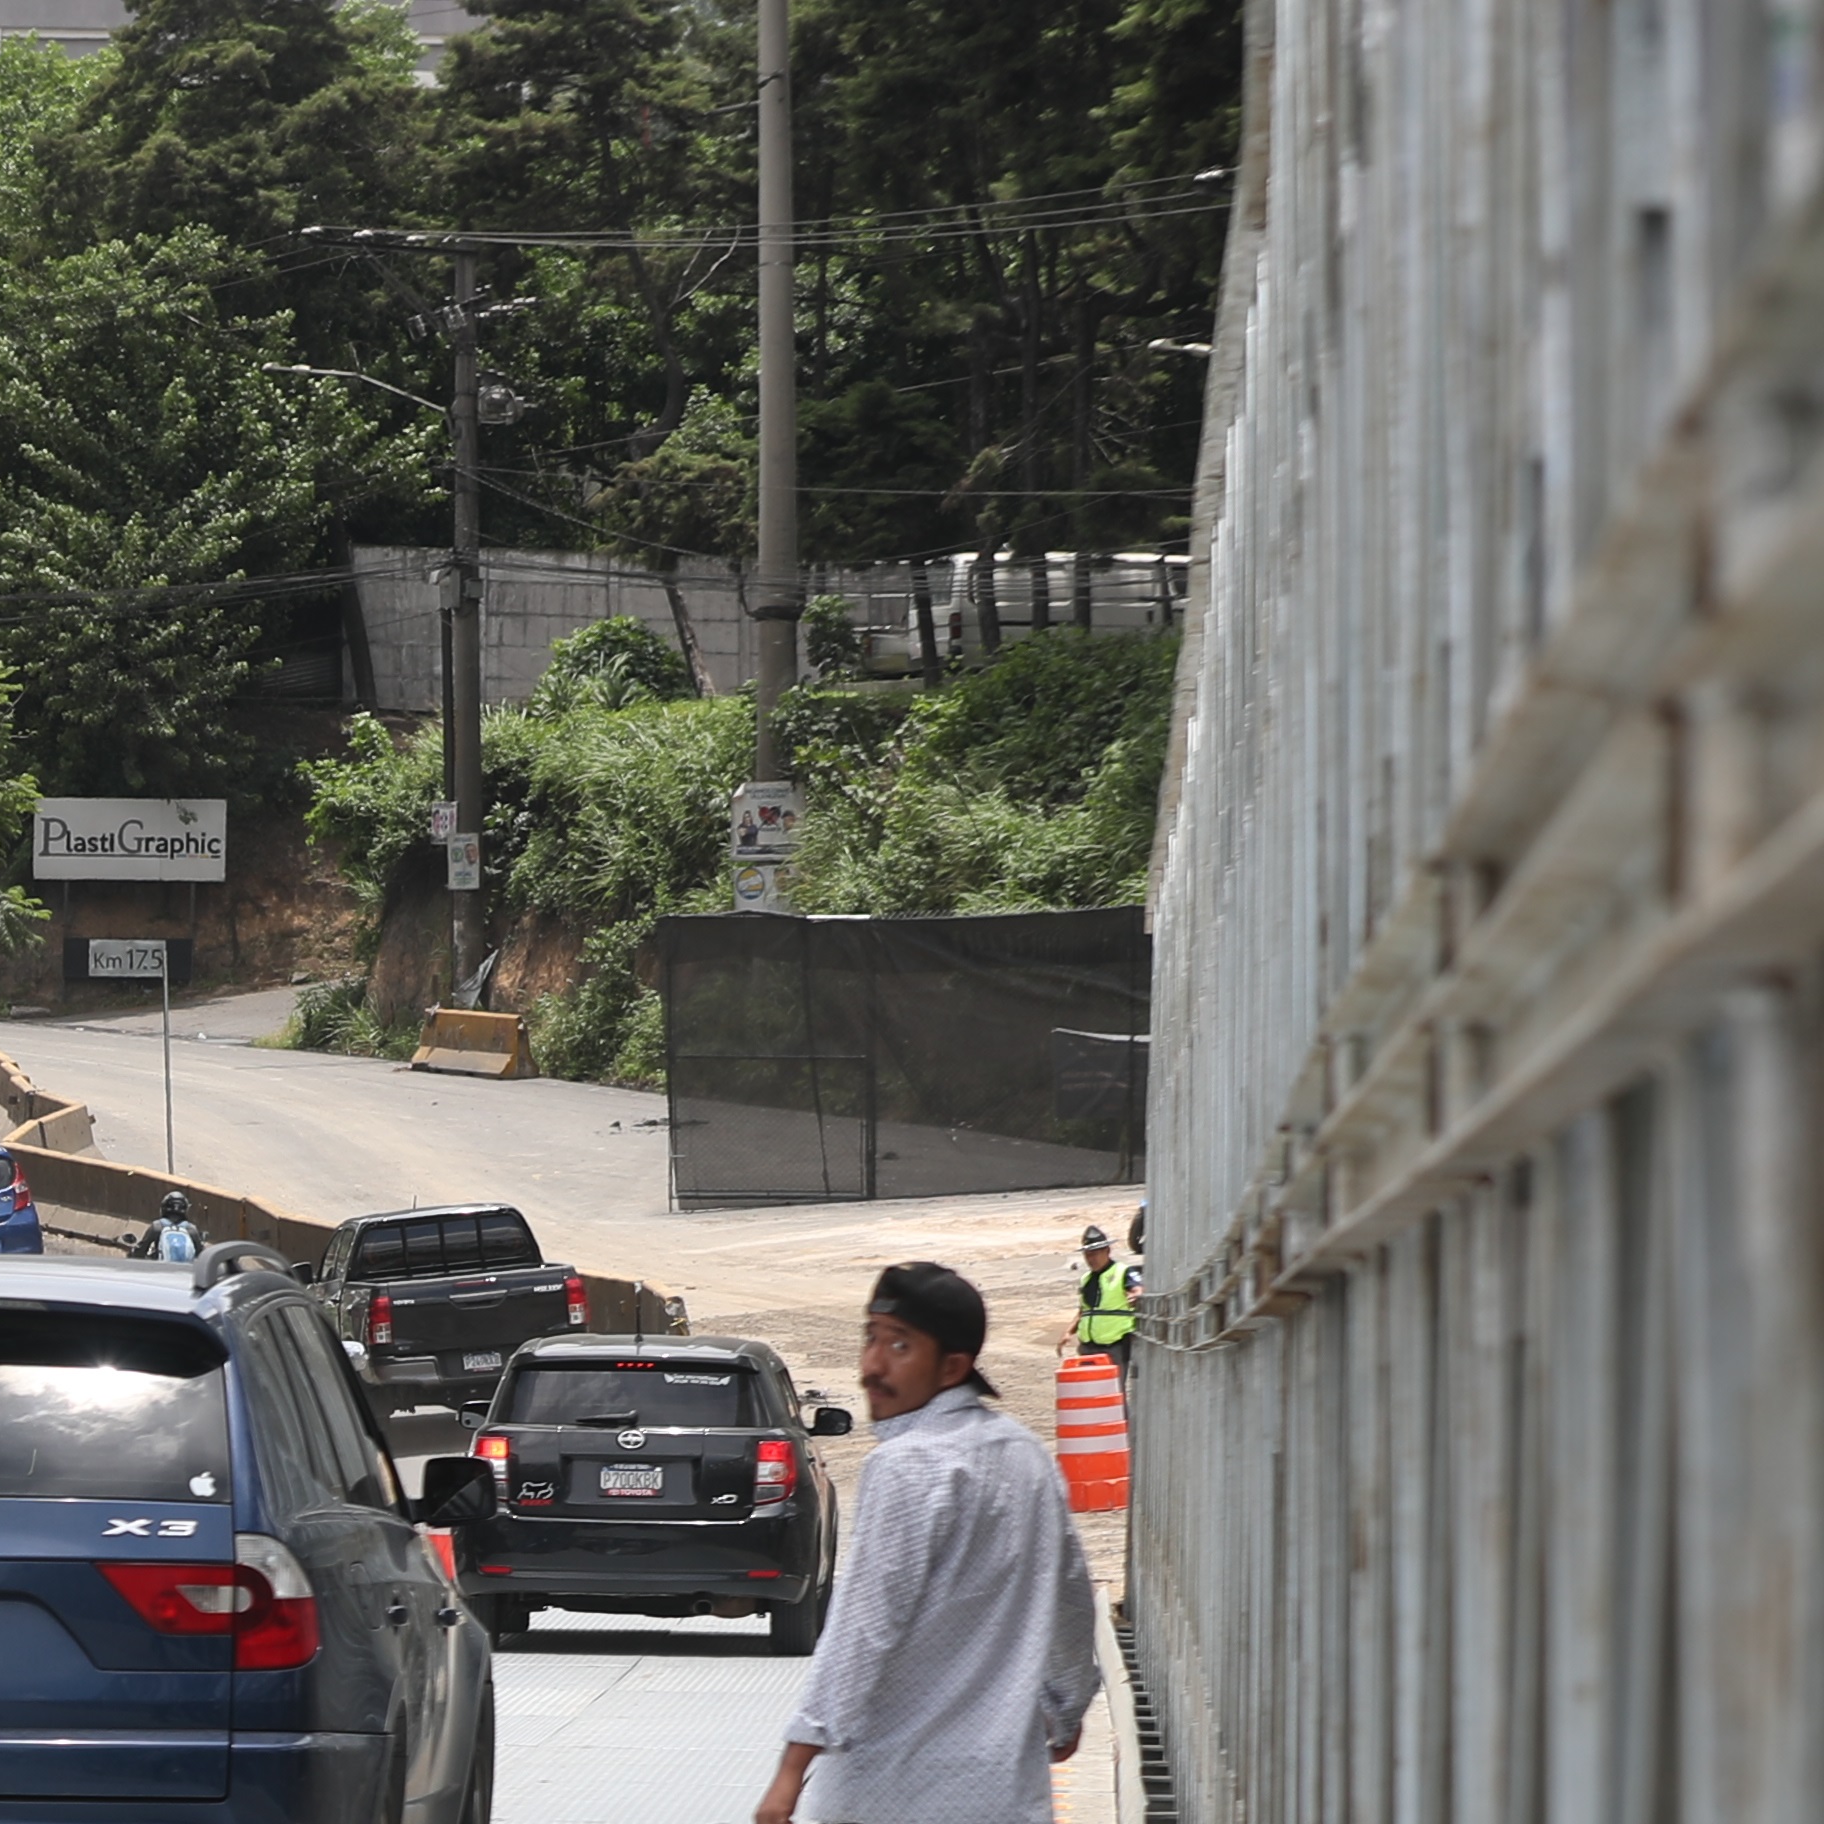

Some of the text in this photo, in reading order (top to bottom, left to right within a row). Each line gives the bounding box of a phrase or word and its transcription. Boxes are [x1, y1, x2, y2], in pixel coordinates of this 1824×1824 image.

[93, 949, 162, 970] Km 17.5
[101, 1519, 198, 1536] X3
